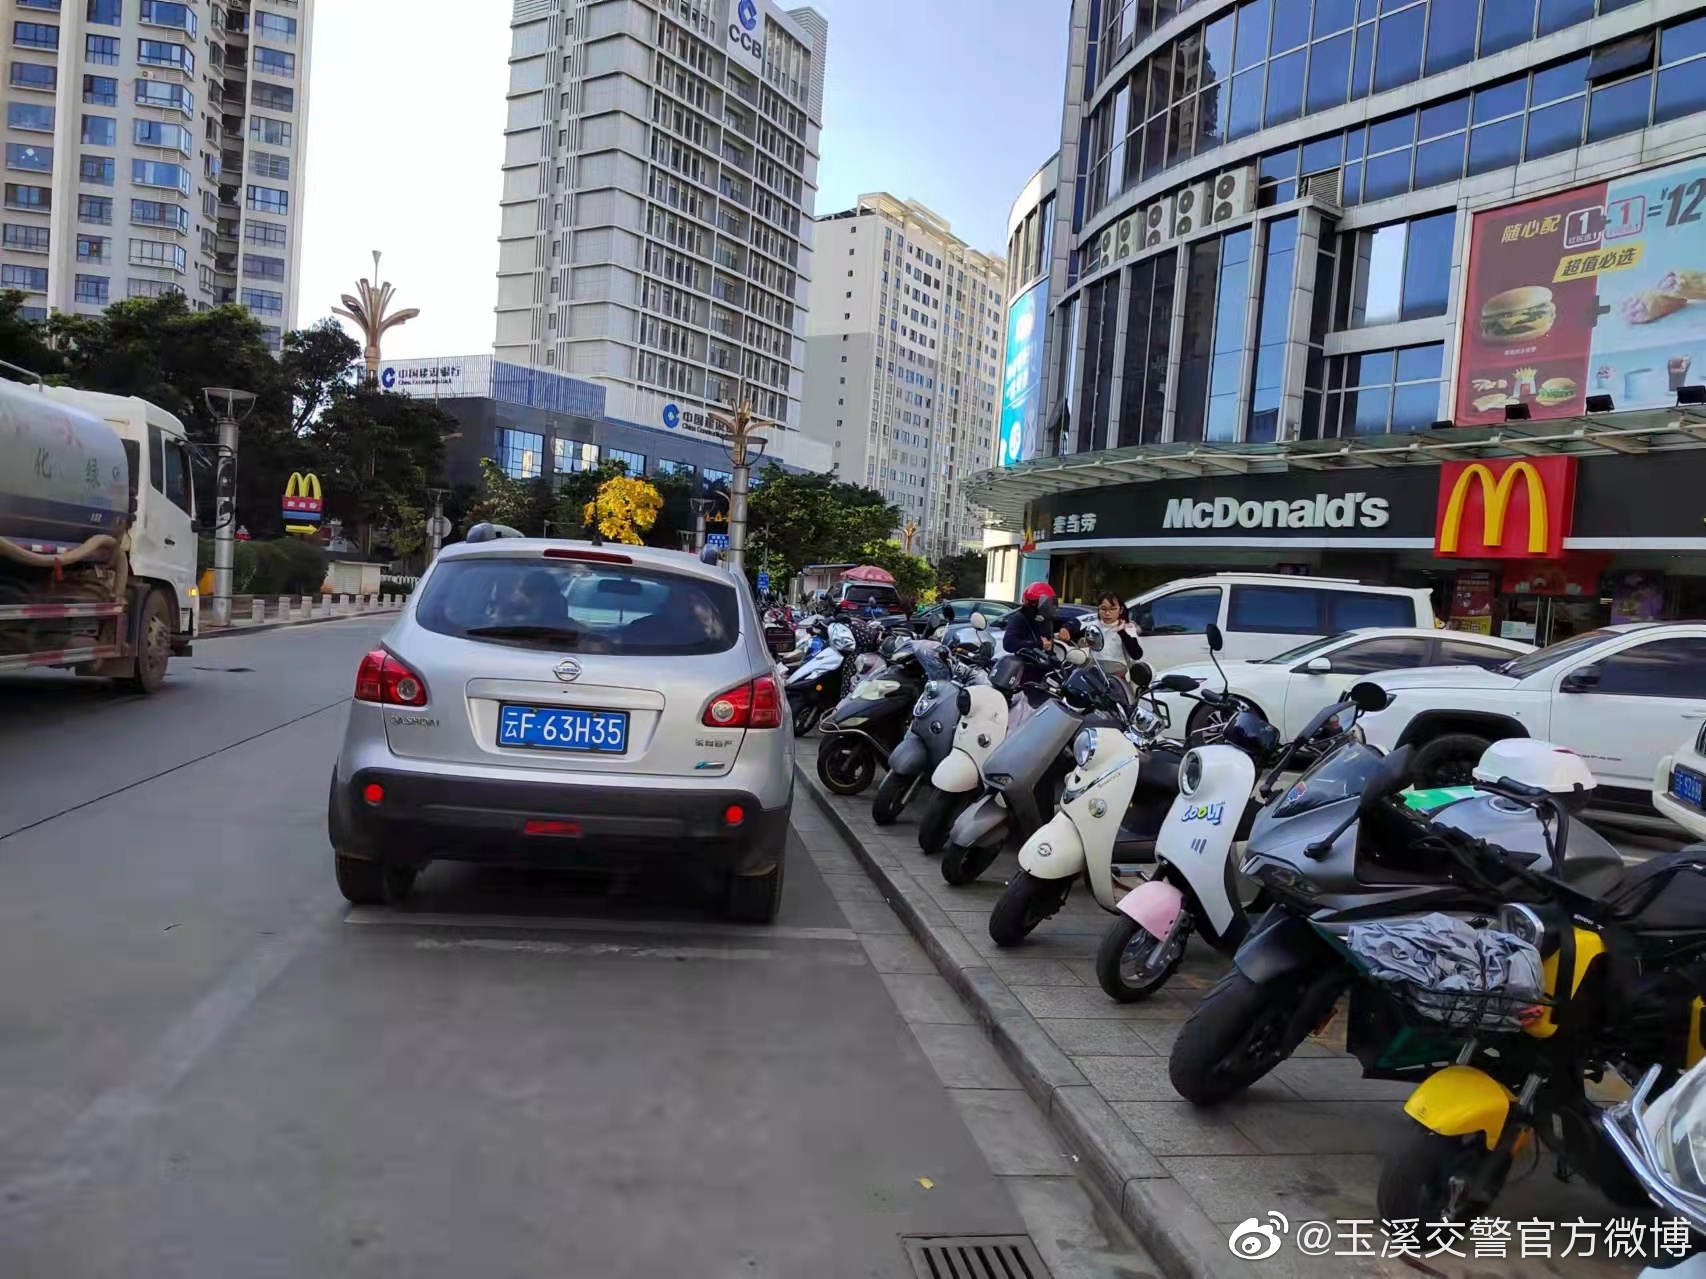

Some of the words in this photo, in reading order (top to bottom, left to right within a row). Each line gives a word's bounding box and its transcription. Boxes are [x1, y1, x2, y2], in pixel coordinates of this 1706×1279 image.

[729, 23, 762, 60] CCB
[1501, 214, 1562, 243] 随心配
[1561, 247, 1637, 278] 超值必选
[1053, 512, 1097, 535] 麦当劳
[1162, 492, 1389, 529] McDonald's
